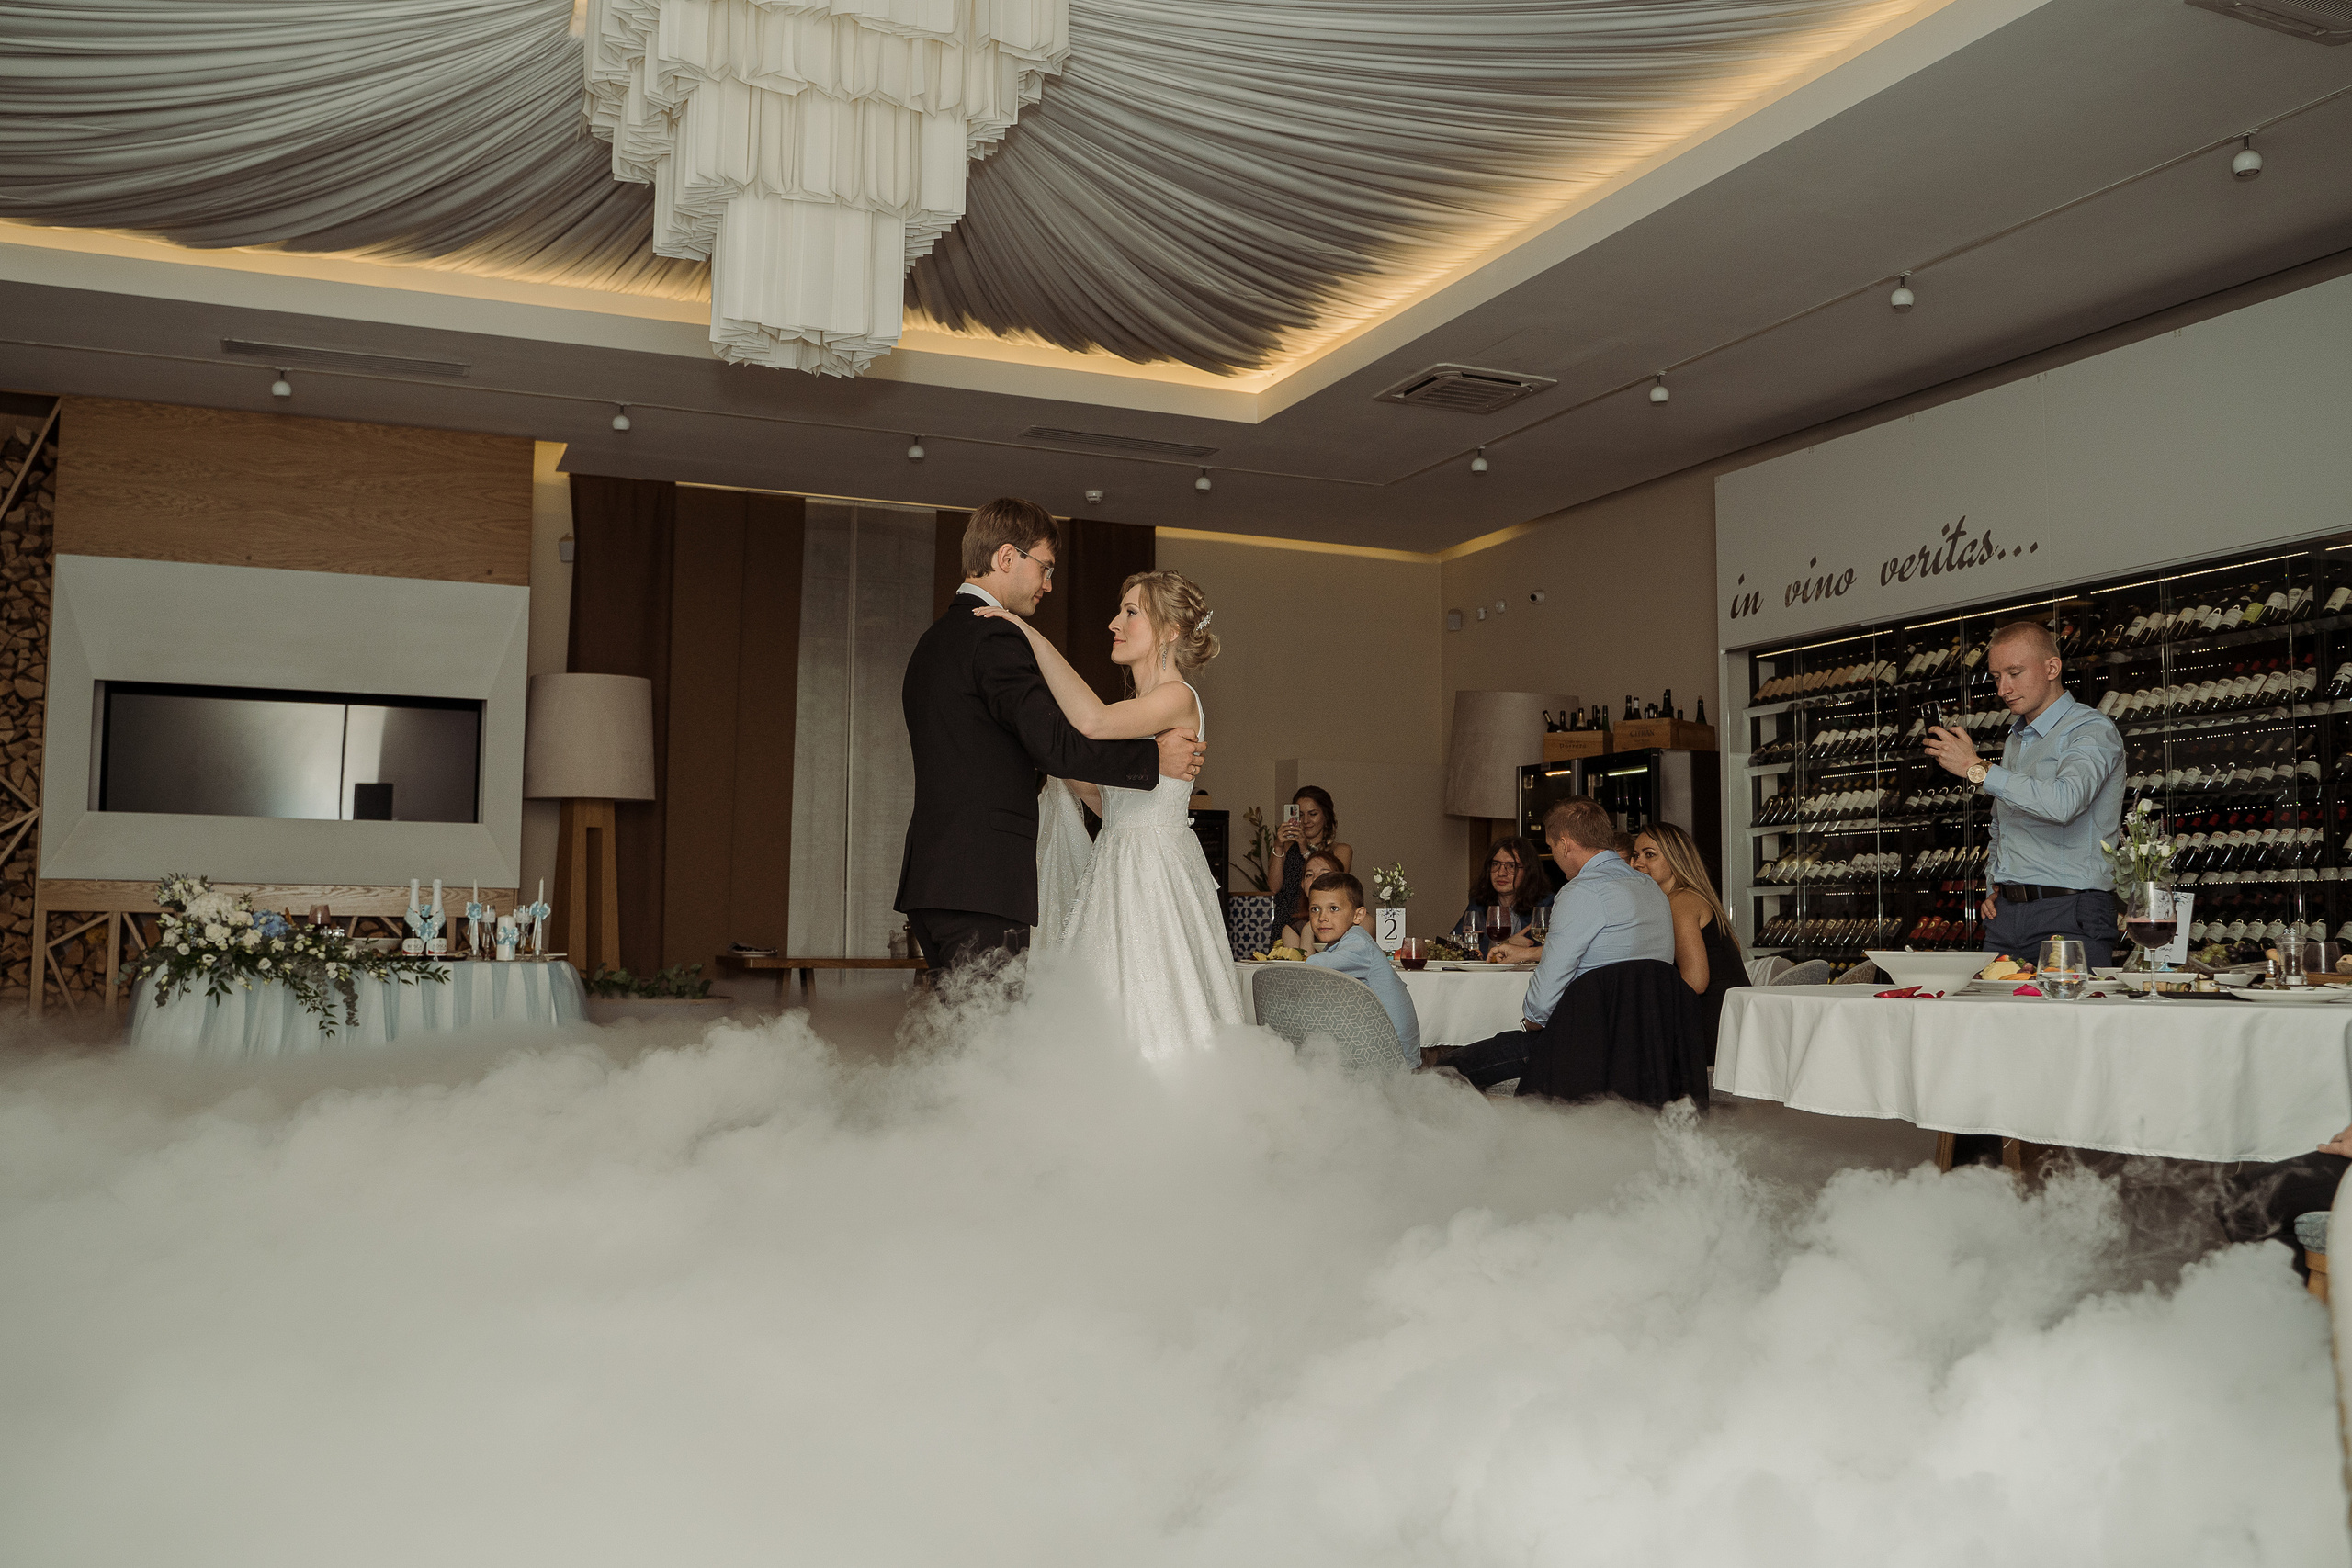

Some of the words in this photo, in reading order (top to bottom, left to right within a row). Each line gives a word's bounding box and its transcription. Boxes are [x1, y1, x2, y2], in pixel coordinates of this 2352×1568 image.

[1730, 573, 1764, 619] in
[1784, 555, 1857, 608] vino
[1880, 514, 2039, 587] veritas...
[1384, 919, 1398, 941] 2
